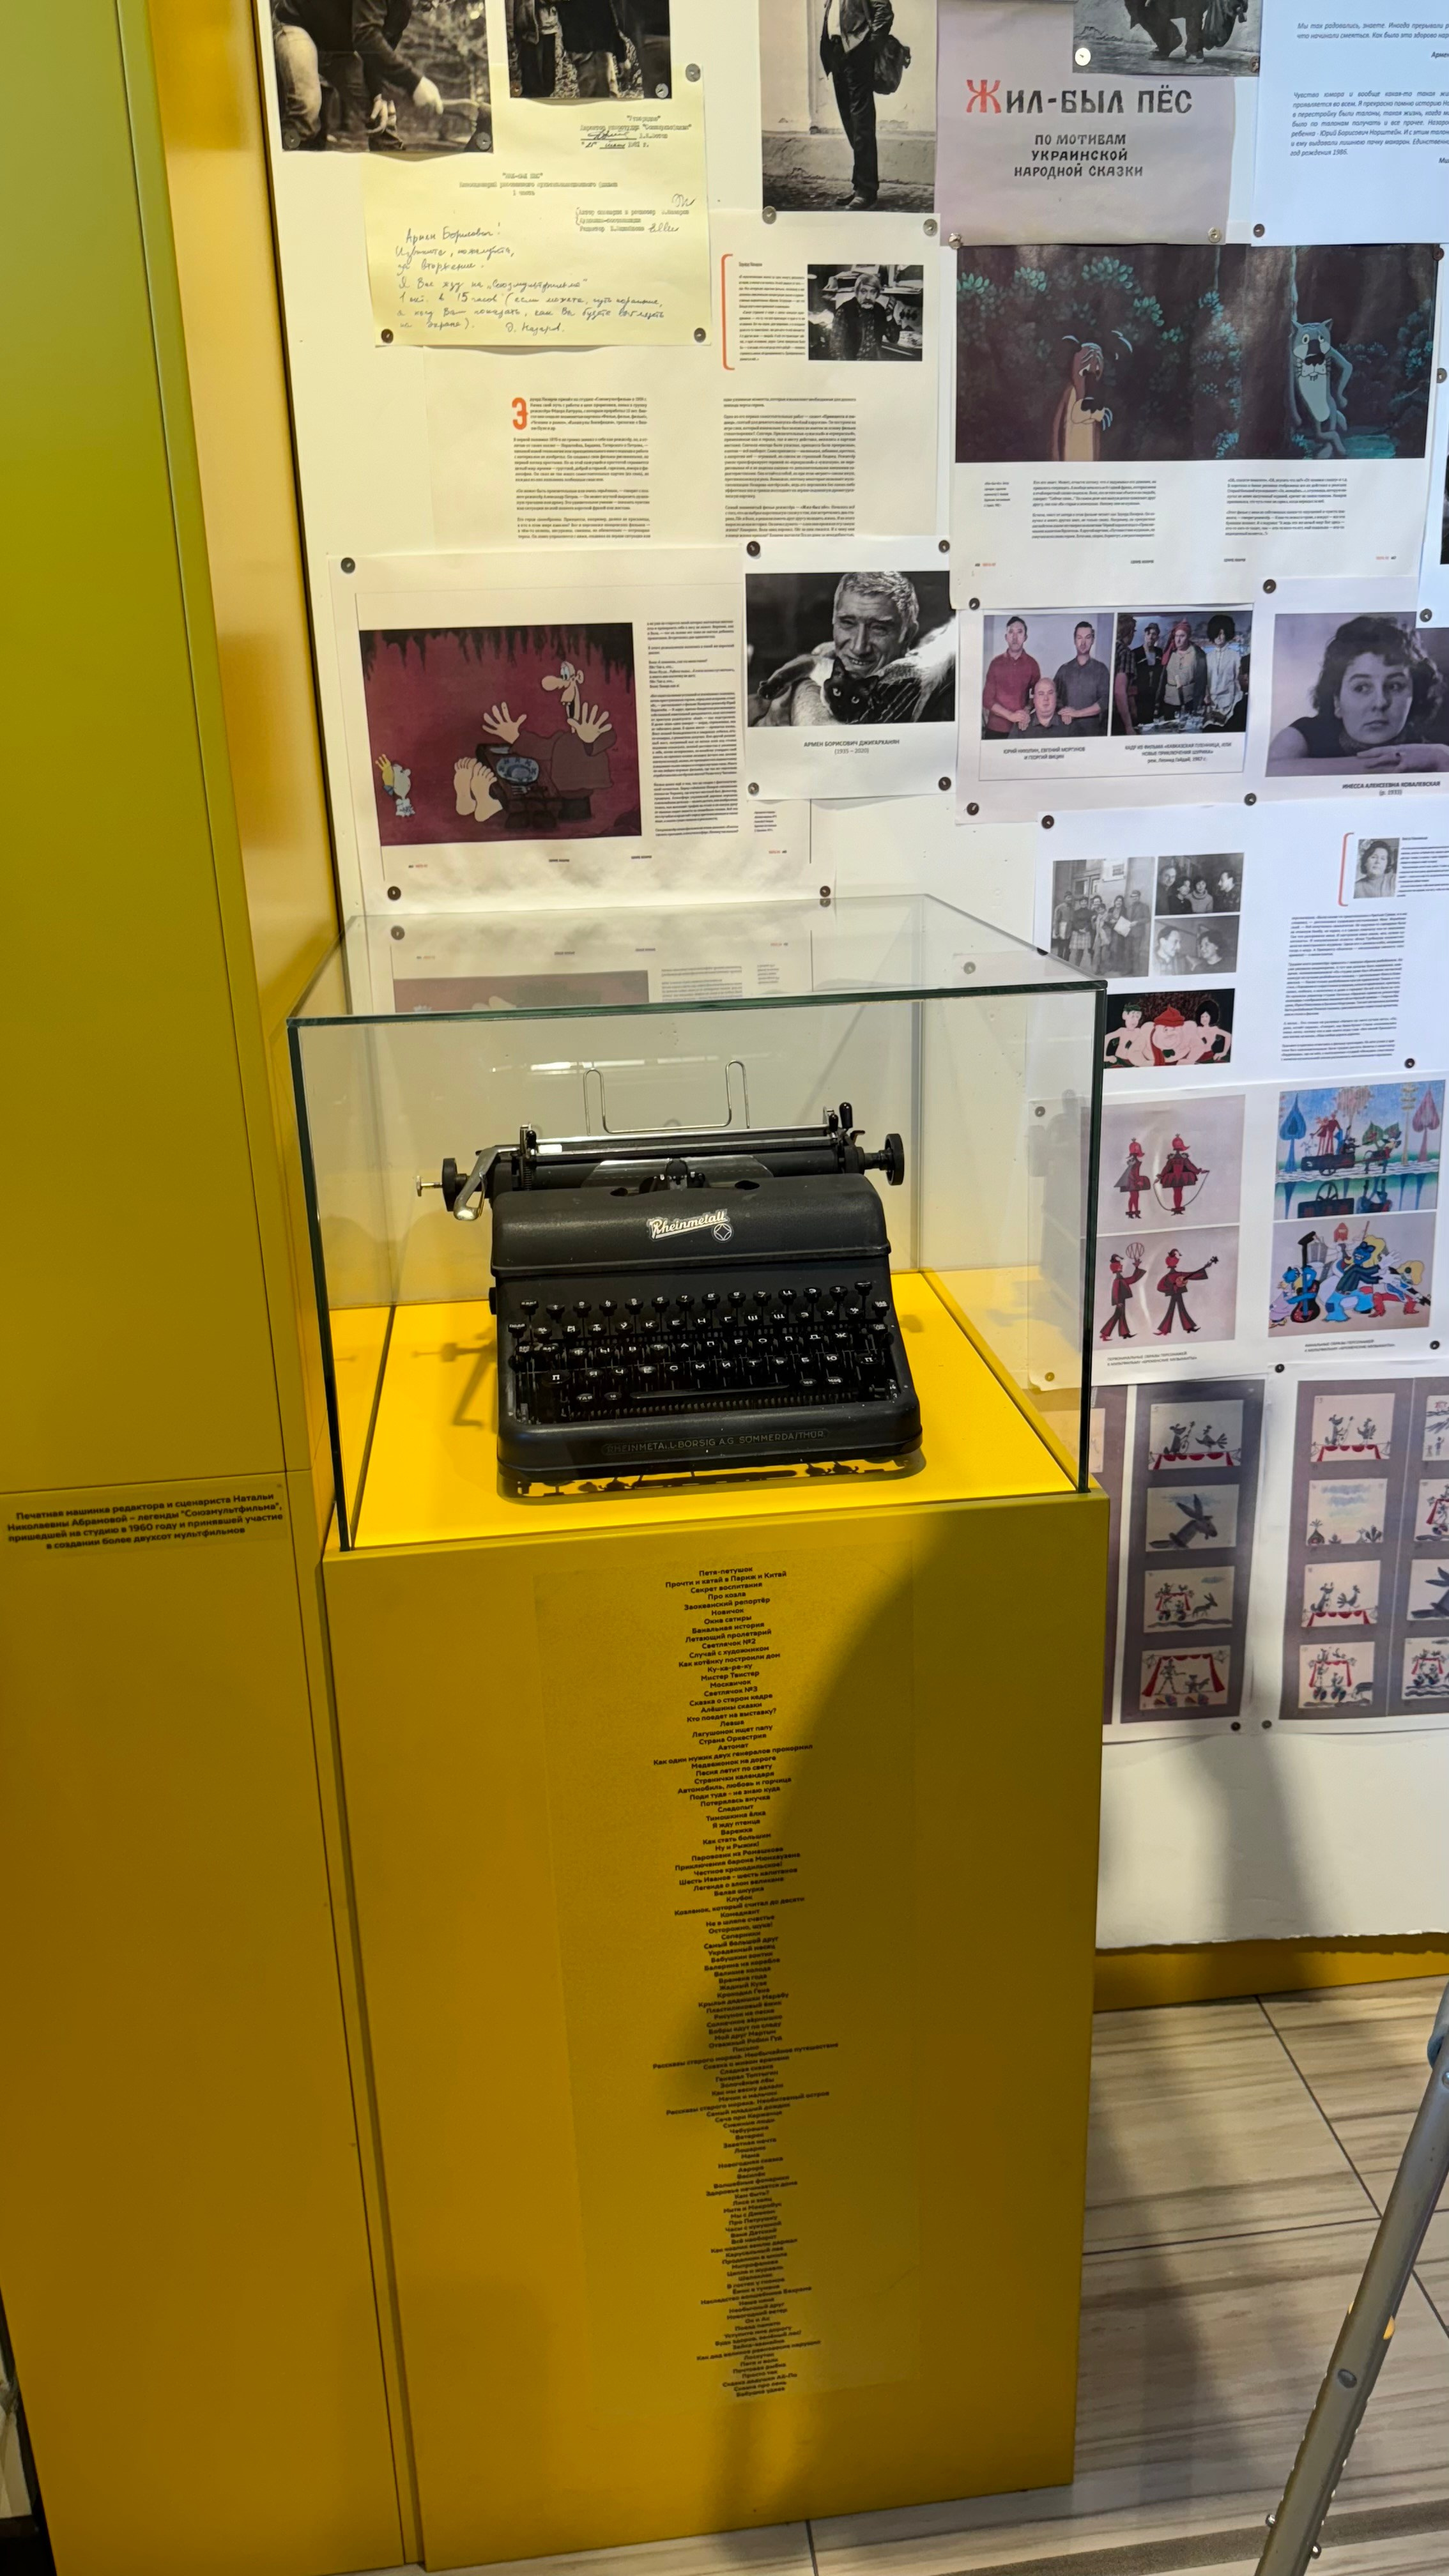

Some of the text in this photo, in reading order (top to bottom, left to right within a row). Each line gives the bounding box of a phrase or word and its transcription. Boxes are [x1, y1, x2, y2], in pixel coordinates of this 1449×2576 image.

[967, 79, 1192, 113] ЖИЛ-БЫЛ ПЁС
[1034, 134, 1126, 145] ПО МОТИВАМ
[1031, 148, 1128, 161] УКРАИНСКОЙ
[1014, 164, 1143, 180] НАРОДНОЙ СКАЗКИ
[512, 397, 528, 431] Э
[649, 1211, 728, 1239] Rheinmetall
[15, 1510, 64, 1520] Печатная
[65, 1507, 110, 1516] машинка
[112, 1502, 165, 1514] редактора
[174, 1497, 231, 1508] сценариста
[233, 1494, 273, 1502] Натальи
[7, 1521, 70, 1531] Николаевны
[71, 1514, 128, 1527] Абрамовой
[137, 1512, 179, 1521] легенды
[8, 1529, 67, 1543] пришедшей
[82, 1528, 119, 1537] студию
[128, 1522, 153, 1532] 1960
[187, 1515, 243, 1528] принявшей
[245, 1514, 283, 1524] участие
[53, 1539, 100, 1549] создании
[102, 1537, 132, 1545] более
[133, 1533, 172, 1543] двухсот
[174, 1528, 245, 1540] мультфильмов
[665, 1581, 694, 1589] Прочти
[702, 1576, 723, 1584] катай
[764, 1570, 786, 1579] Китай
[719, 1582, 762, 1591] воспитания
[734, 1597, 770, 1607] репортёр
[685, 1628, 772, 1643] Летающий пролетарий
[692, 1625, 732, 1634] Банальная
[702, 1641, 741, 1649] Светлячок
[689, 1650, 716, 1659] Случай
[723, 1646, 769, 1656] художником
[724, 1654, 764, 1663] построили
[710, 1680, 751, 1688] Москвичок
[703, 1689, 743, 1697] Светлячок
[700, 1705, 736, 1713] Алёшины
[739, 1707, 776, 1717] выставку?
[692, 1728, 733, 1738] Лягушонок
[698, 1733, 767, 1745] Страна Оркестрия
[732, 1749, 770, 1757] генералов
[772, 1744, 813, 1754] прокормил
[717, 1804, 754, 1813] Следопыт
[720, 1827, 753, 1836] Варежка
